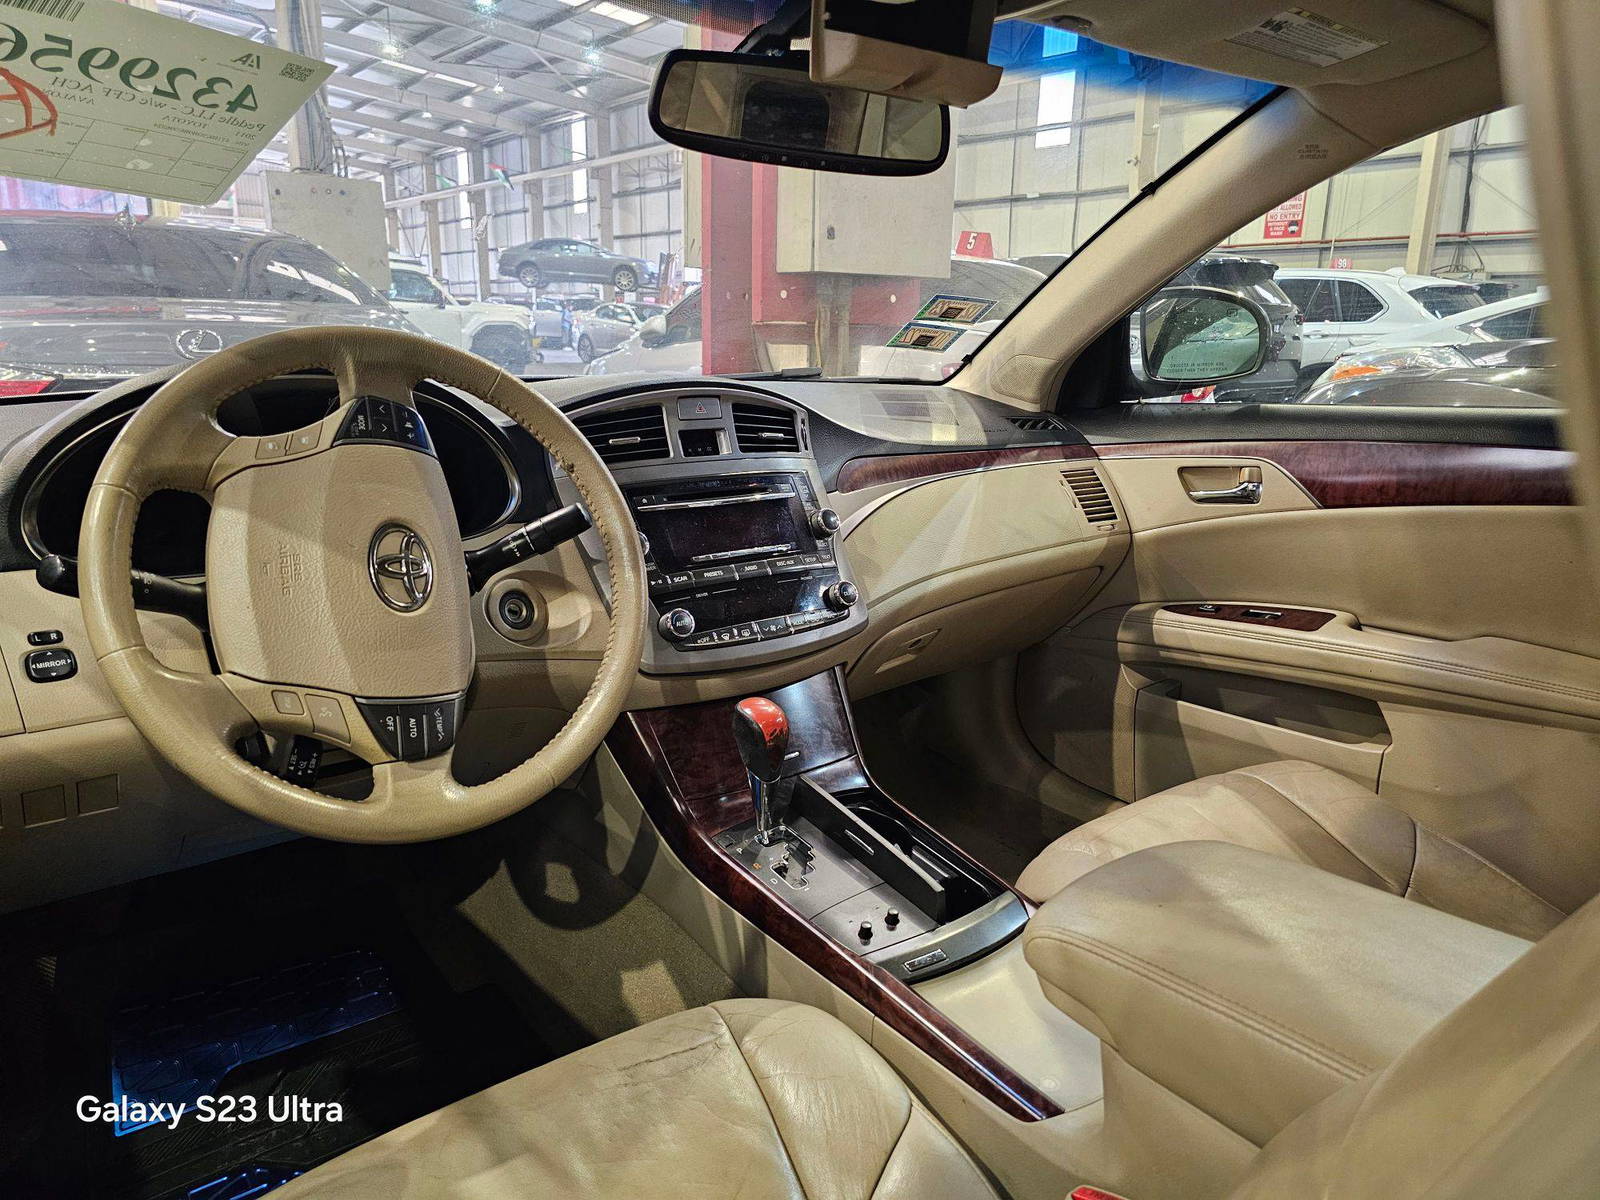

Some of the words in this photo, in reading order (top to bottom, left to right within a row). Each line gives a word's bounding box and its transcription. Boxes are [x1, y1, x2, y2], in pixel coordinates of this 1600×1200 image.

[966, 232, 978, 250] 5
[357, 415, 366, 431] MODE
[280, 543, 291, 597] AIRBAG
[293, 554, 303, 582] SRS
[36, 659, 67, 669] MIRROR
[385, 715, 394, 732] OFF
[408, 717, 418, 738] AUTO
